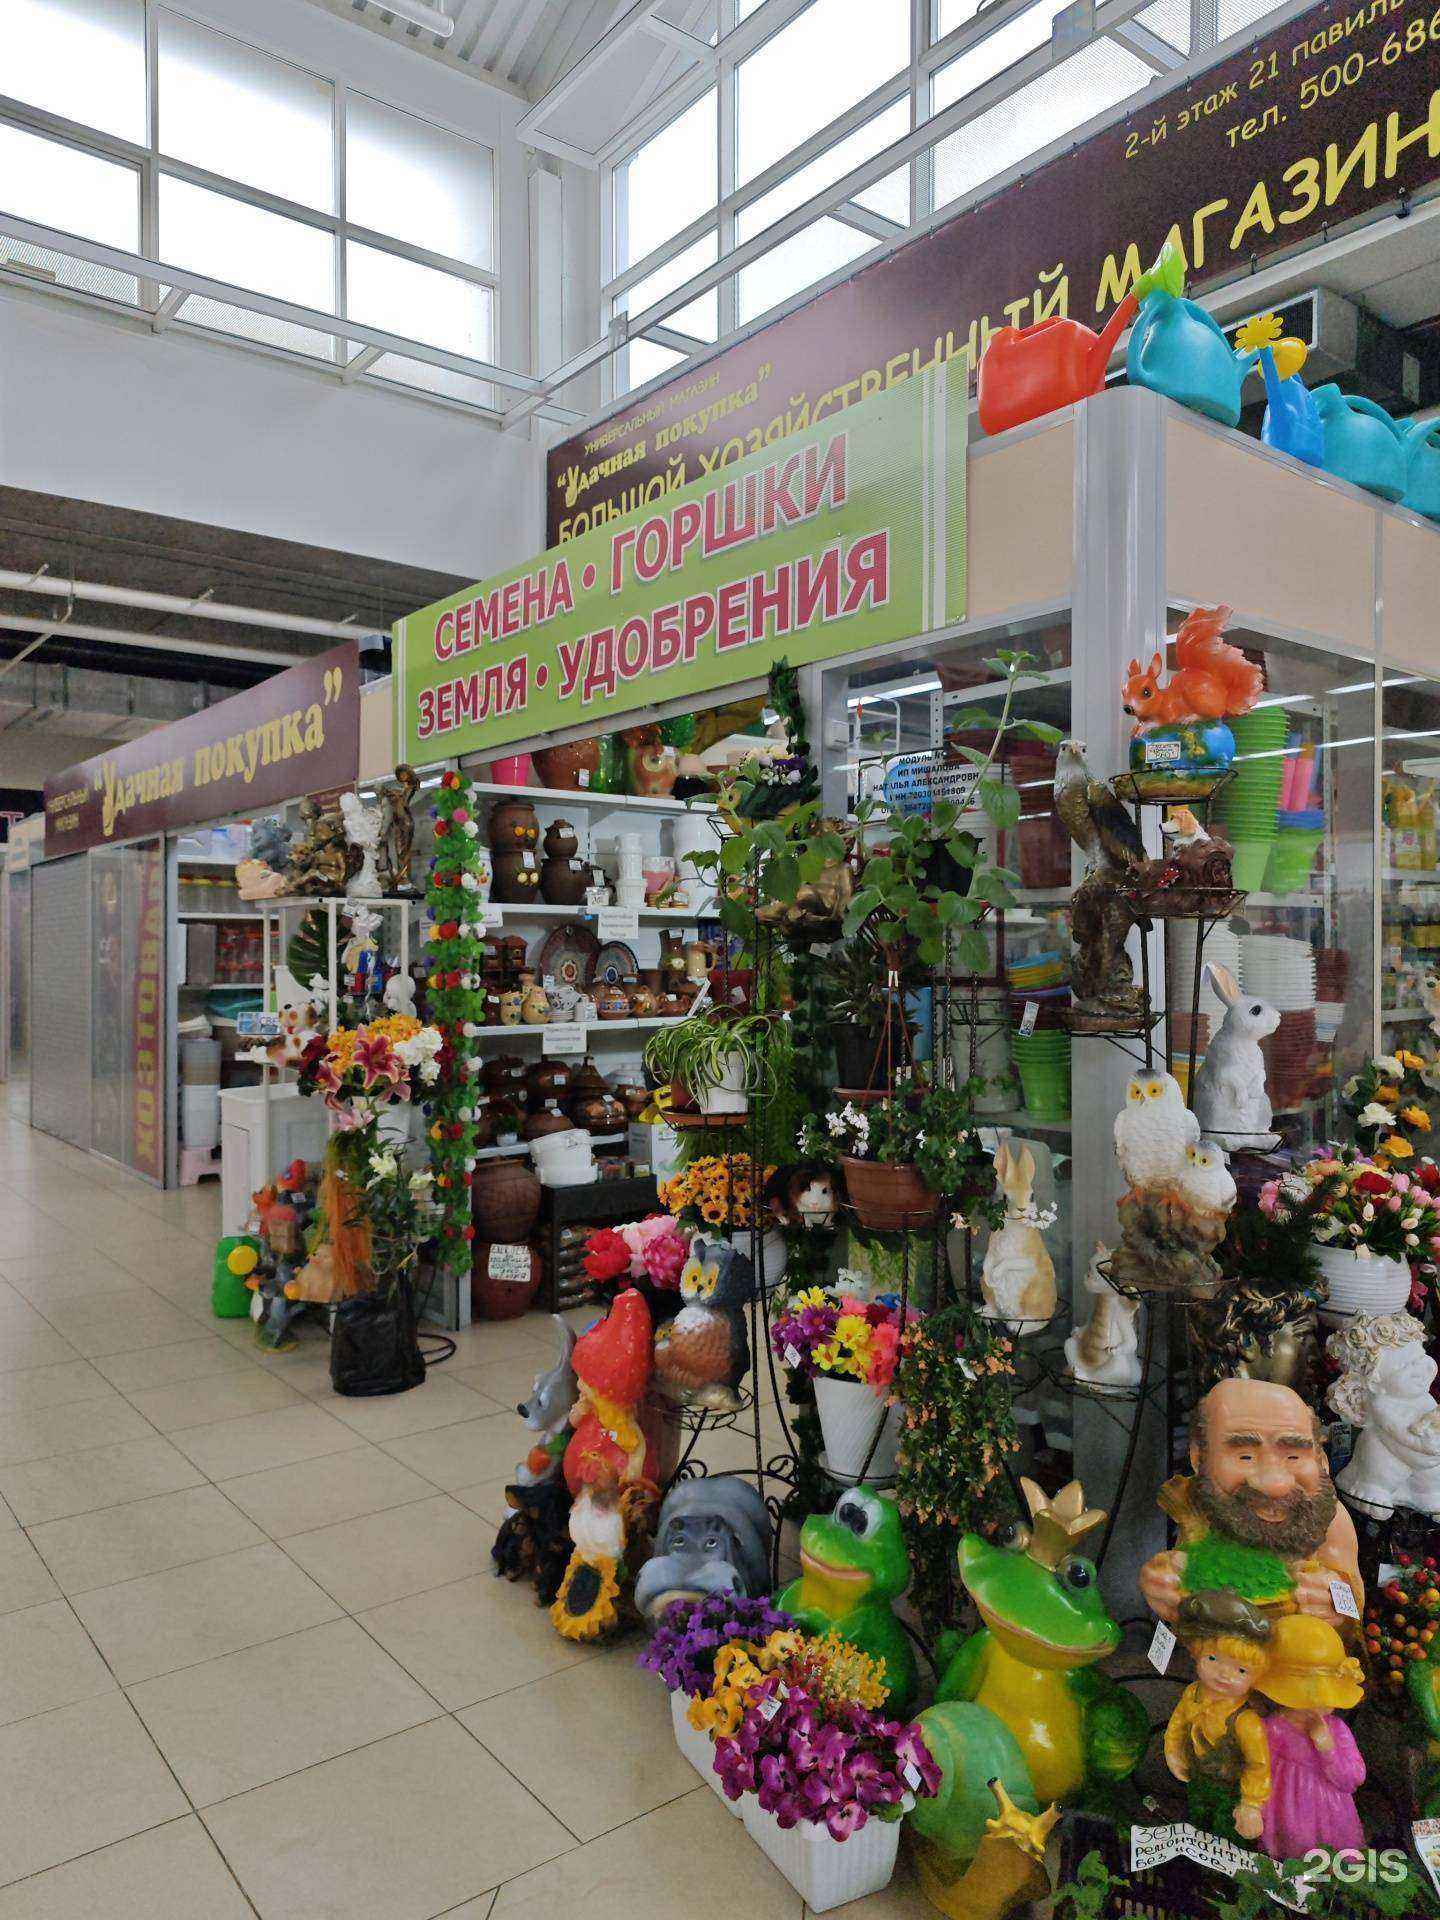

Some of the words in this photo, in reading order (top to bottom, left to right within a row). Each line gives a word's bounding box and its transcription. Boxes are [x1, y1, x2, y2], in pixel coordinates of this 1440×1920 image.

[1125, 114, 1167, 159] 2-й
[1177, 81, 1238, 131] этаж
[1249, 50, 1279, 90] 21
[1226, 104, 1287, 148] тел.
[435, 559, 573, 661] СЕМЕНА
[611, 432, 849, 595] ГОРШКИ
[417, 656, 528, 740] ЗЕМЛЯ
[556, 528, 890, 705] УДОБРЕНИЯ
